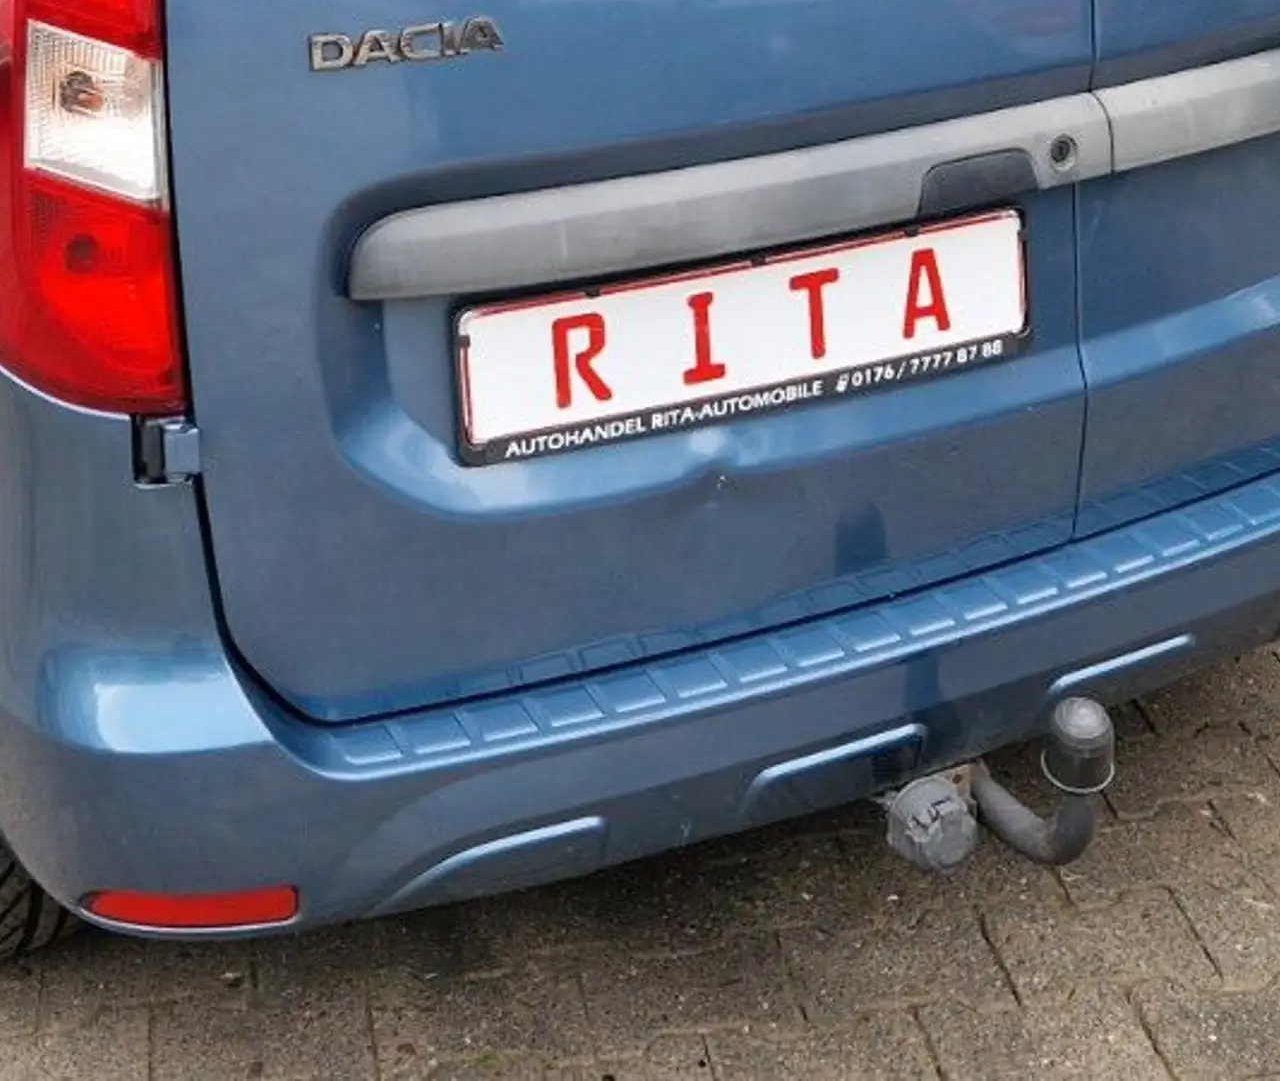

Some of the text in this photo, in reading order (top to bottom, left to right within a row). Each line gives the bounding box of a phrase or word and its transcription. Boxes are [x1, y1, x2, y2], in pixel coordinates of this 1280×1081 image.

[309, 14, 504, 73] DACIA
[504, 415, 646, 459] AUTOHANDEL
[651, 379, 823, 430] RITA-AUTOMOBILE
